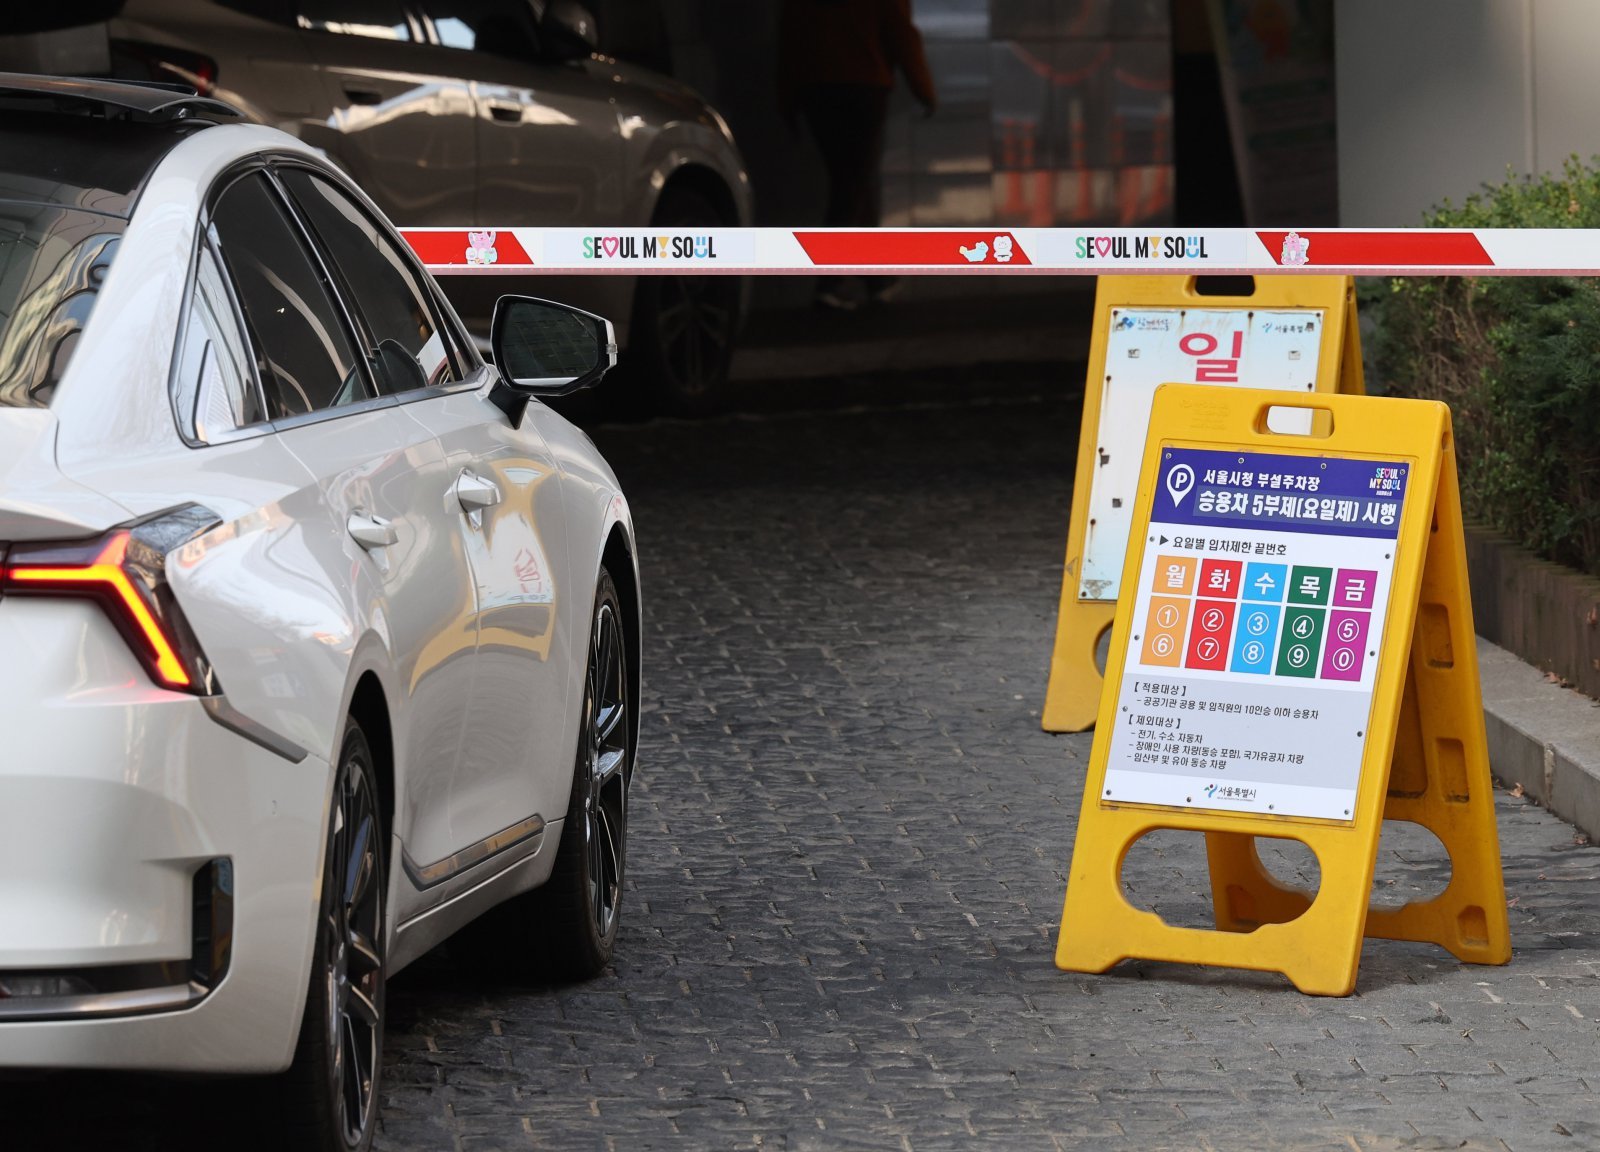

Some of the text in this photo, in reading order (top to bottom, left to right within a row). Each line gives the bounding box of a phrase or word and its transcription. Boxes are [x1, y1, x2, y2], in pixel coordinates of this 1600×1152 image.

[582, 236, 638, 259] SEOUL
[672, 236, 717, 259] SOUL
[1075, 236, 1131, 259] SEOUL
[1164, 236, 1208, 259] SOUL
[1179, 331, 1243, 382] 일
[1175, 472, 1188, 489] P
[1203, 469, 1320, 492] 서울시청 부설주차장
[1198, 490, 1397, 525] 승용차 5부제(요일제) 시행
[1173, 536, 1287, 556] 요일별 입차제한 끝번호
[1166, 564, 1366, 602] 월 화 수 목 금
[1143, 696, 1319, 720] 공공기관 공용 및 임직원의 10인승 이하 승용차
[1158, 731, 1175, 742] 수소
[1177, 733, 1203, 744] 자동차
[1134, 752, 1227, 770] 임산부 및 유아 동승 차량
[1135, 741, 1161, 752] 장애인
[1163, 743, 1180, 754] 사용
[1243, 750, 1285, 763] 국가유공자
[1287, 754, 1304, 765] 차량
[1218, 786, 1257, 799] 서울특별시
